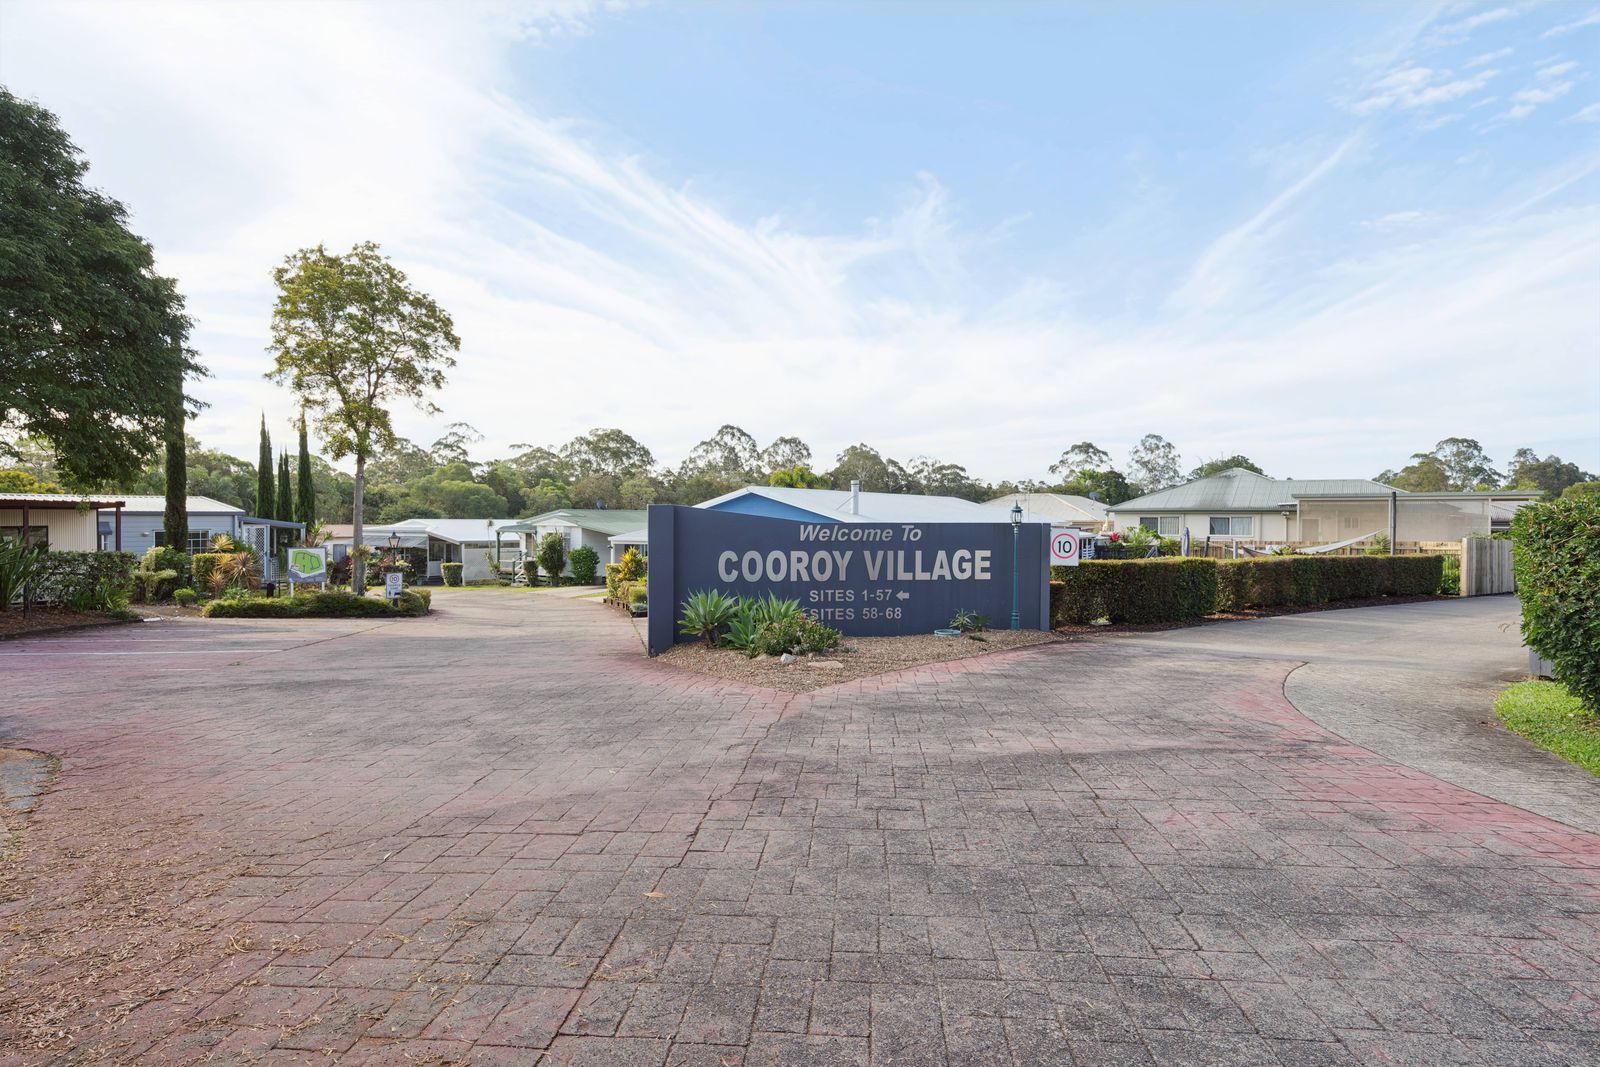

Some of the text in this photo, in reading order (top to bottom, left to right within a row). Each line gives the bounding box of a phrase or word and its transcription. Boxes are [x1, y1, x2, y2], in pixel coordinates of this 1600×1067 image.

[800, 524, 922, 541] Welcome To
[1057, 540, 1072, 554] 10
[718, 549, 992, 582] COOROY VILLAGE
[809, 589, 893, 602] SITES 1-57
[810, 607, 902, 620] SITES 58-68
